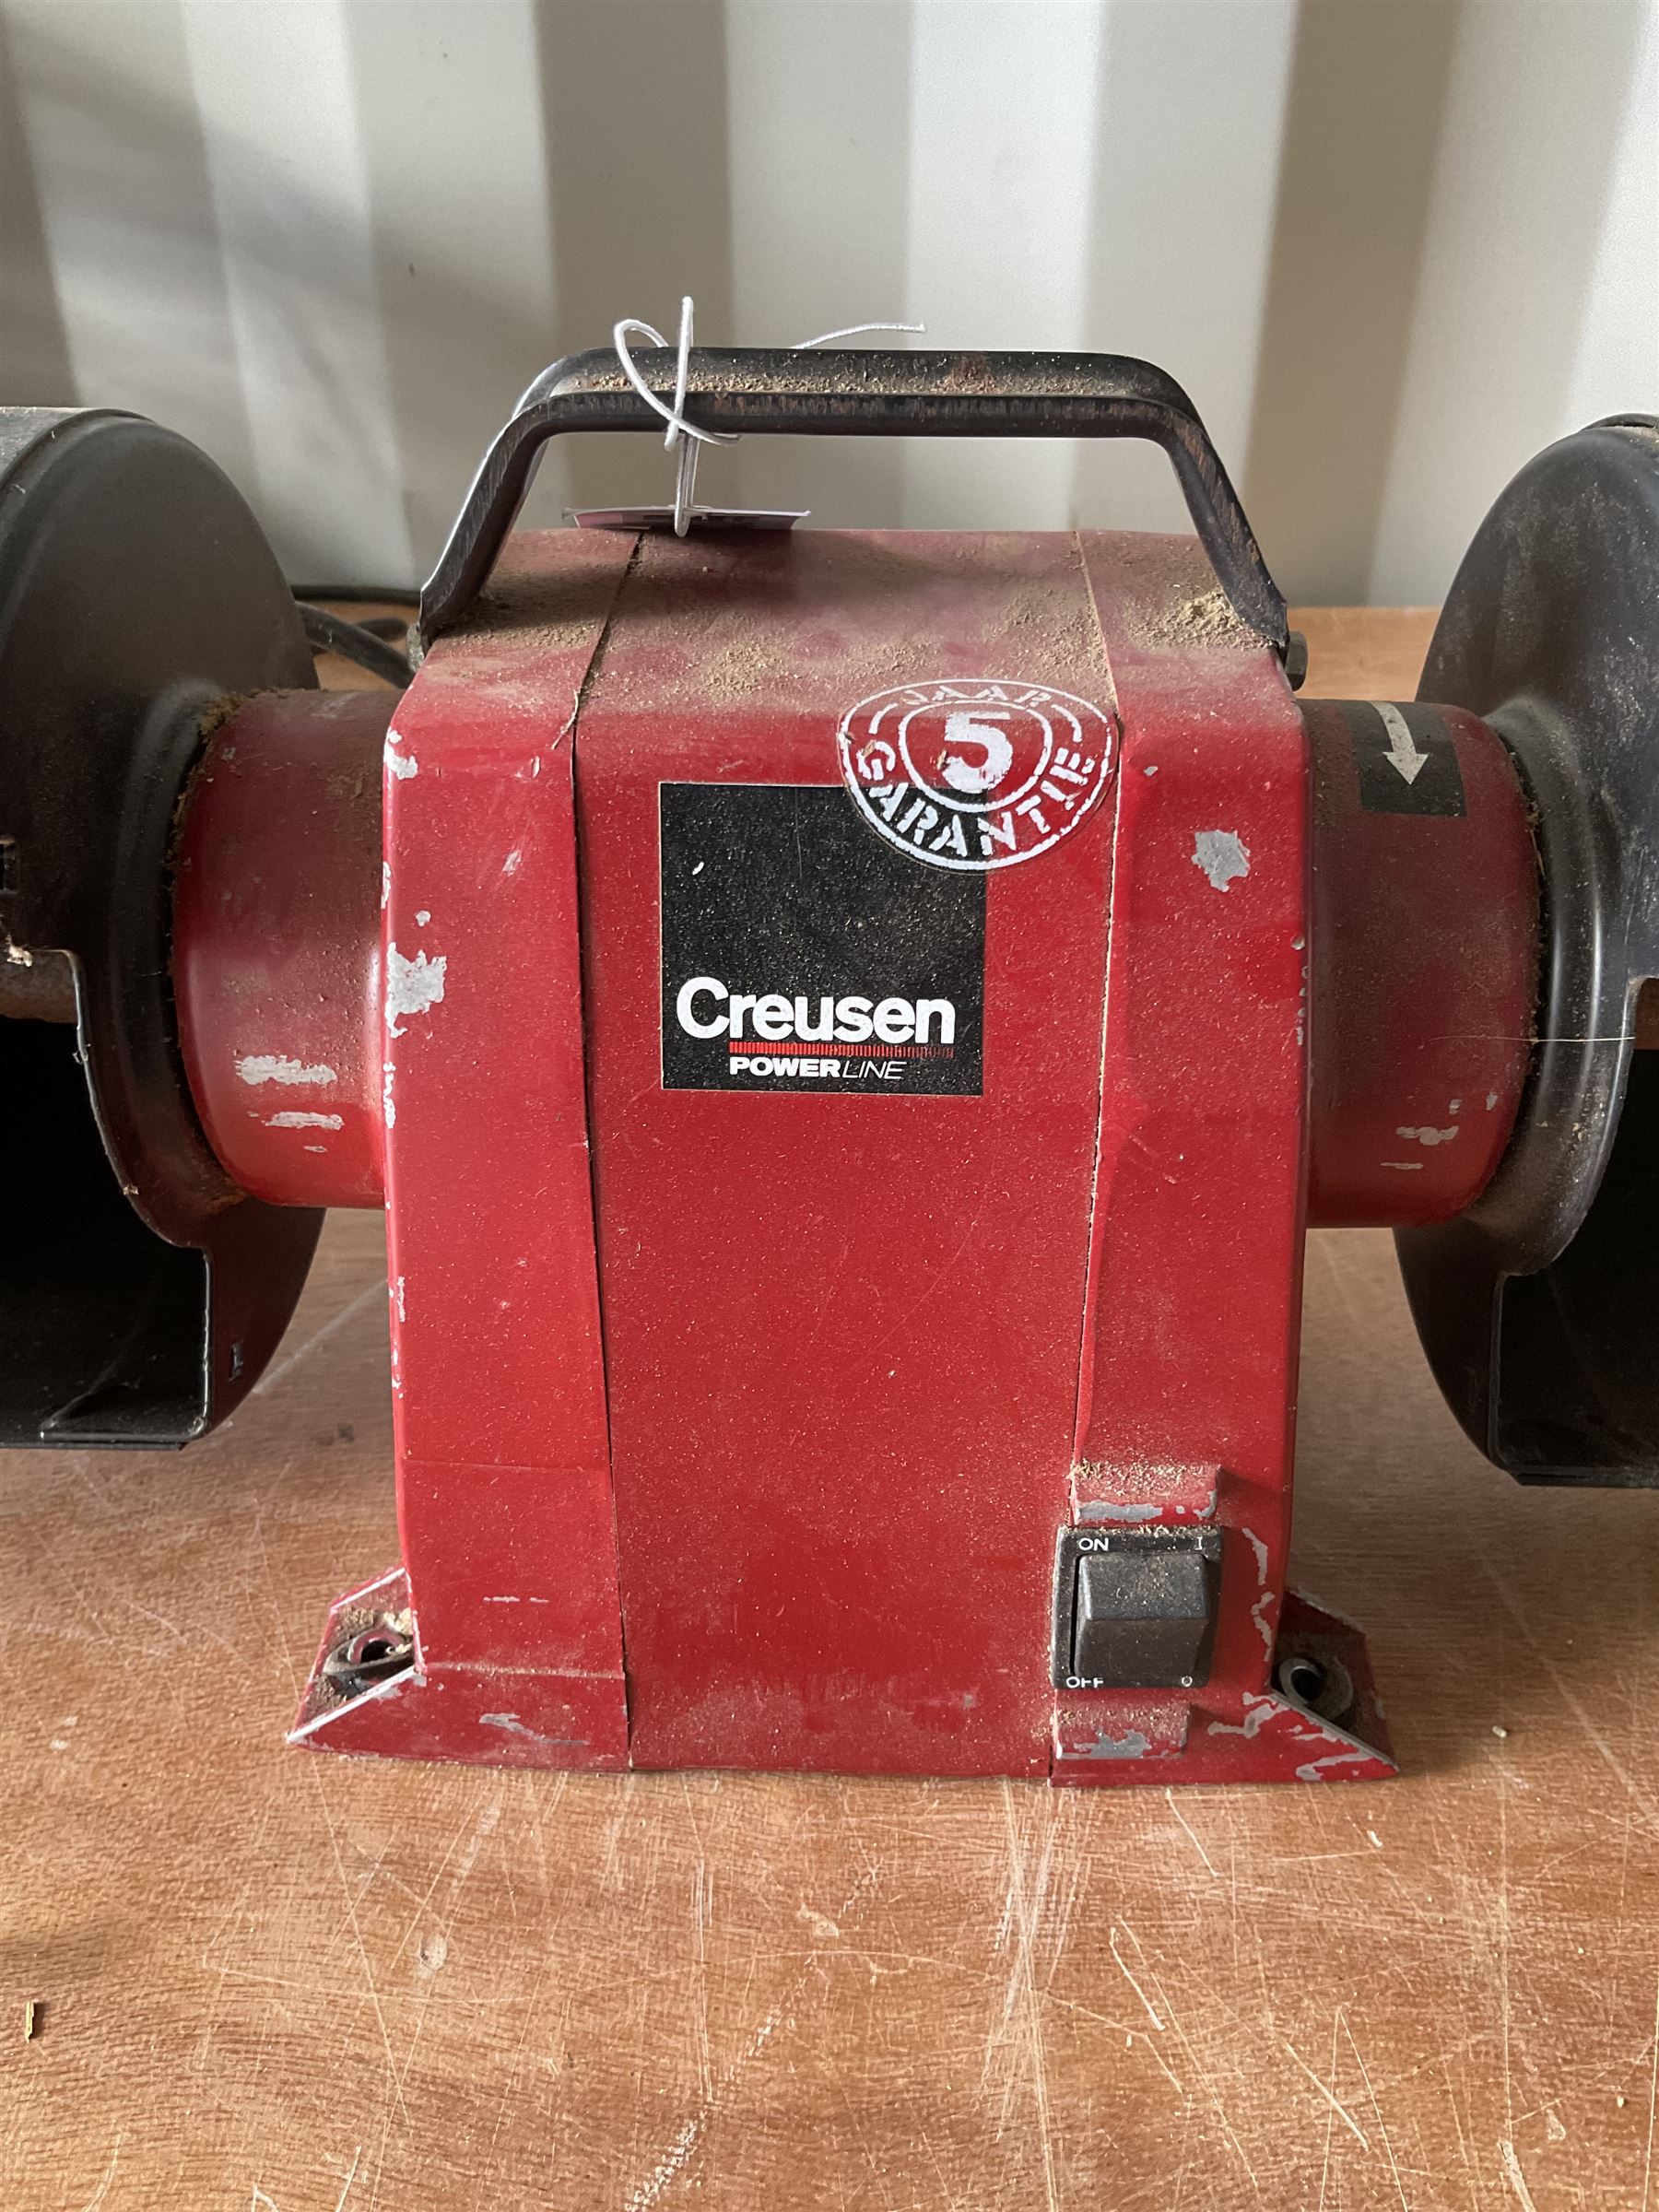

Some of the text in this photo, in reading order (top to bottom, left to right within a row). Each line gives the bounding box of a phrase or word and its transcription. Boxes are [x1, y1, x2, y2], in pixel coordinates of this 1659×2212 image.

[942, 712, 1013, 794] 5
[856, 741, 1095, 857] GARANTIE
[677, 976, 956, 1044] Creusen
[1078, 1537, 1109, 1551] ON
[1065, 1677, 1104, 1688] OFF
